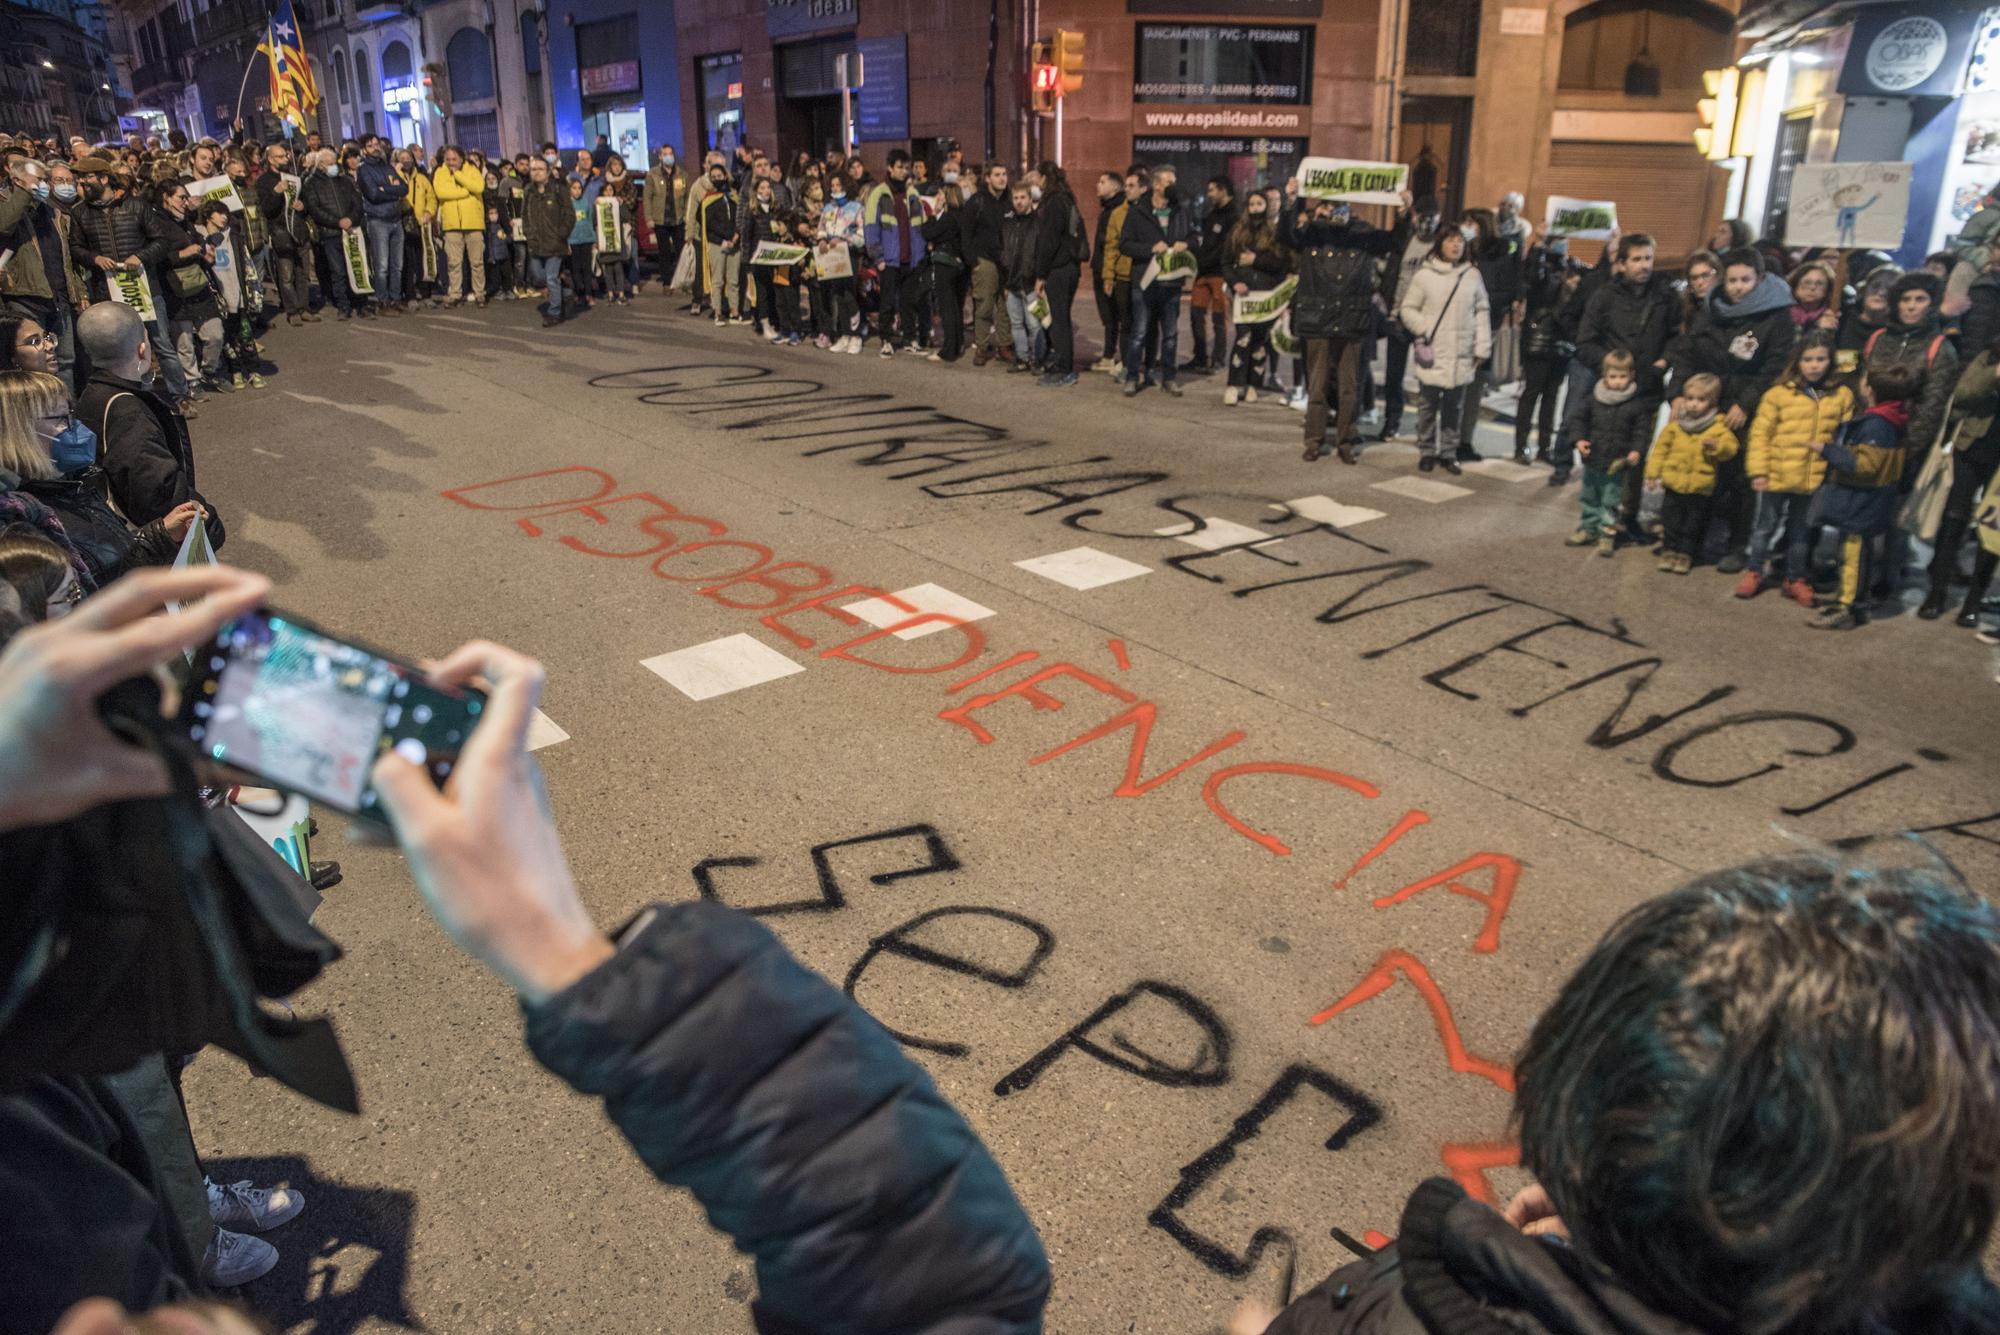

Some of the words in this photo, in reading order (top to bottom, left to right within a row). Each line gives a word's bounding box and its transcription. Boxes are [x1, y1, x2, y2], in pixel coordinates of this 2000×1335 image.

[1219, 29, 1240, 42] PVC
[1248, 30, 1300, 43] PERSIANES
[1134, 83, 1205, 97] MOSQUITERES
[1146, 110, 1299, 129] www.espaiideal.com
[1136, 140, 1191, 152] MAMPARES
[1200, 141, 1244, 153] TANQUES
[1252, 142, 1294, 154] ESCALES
